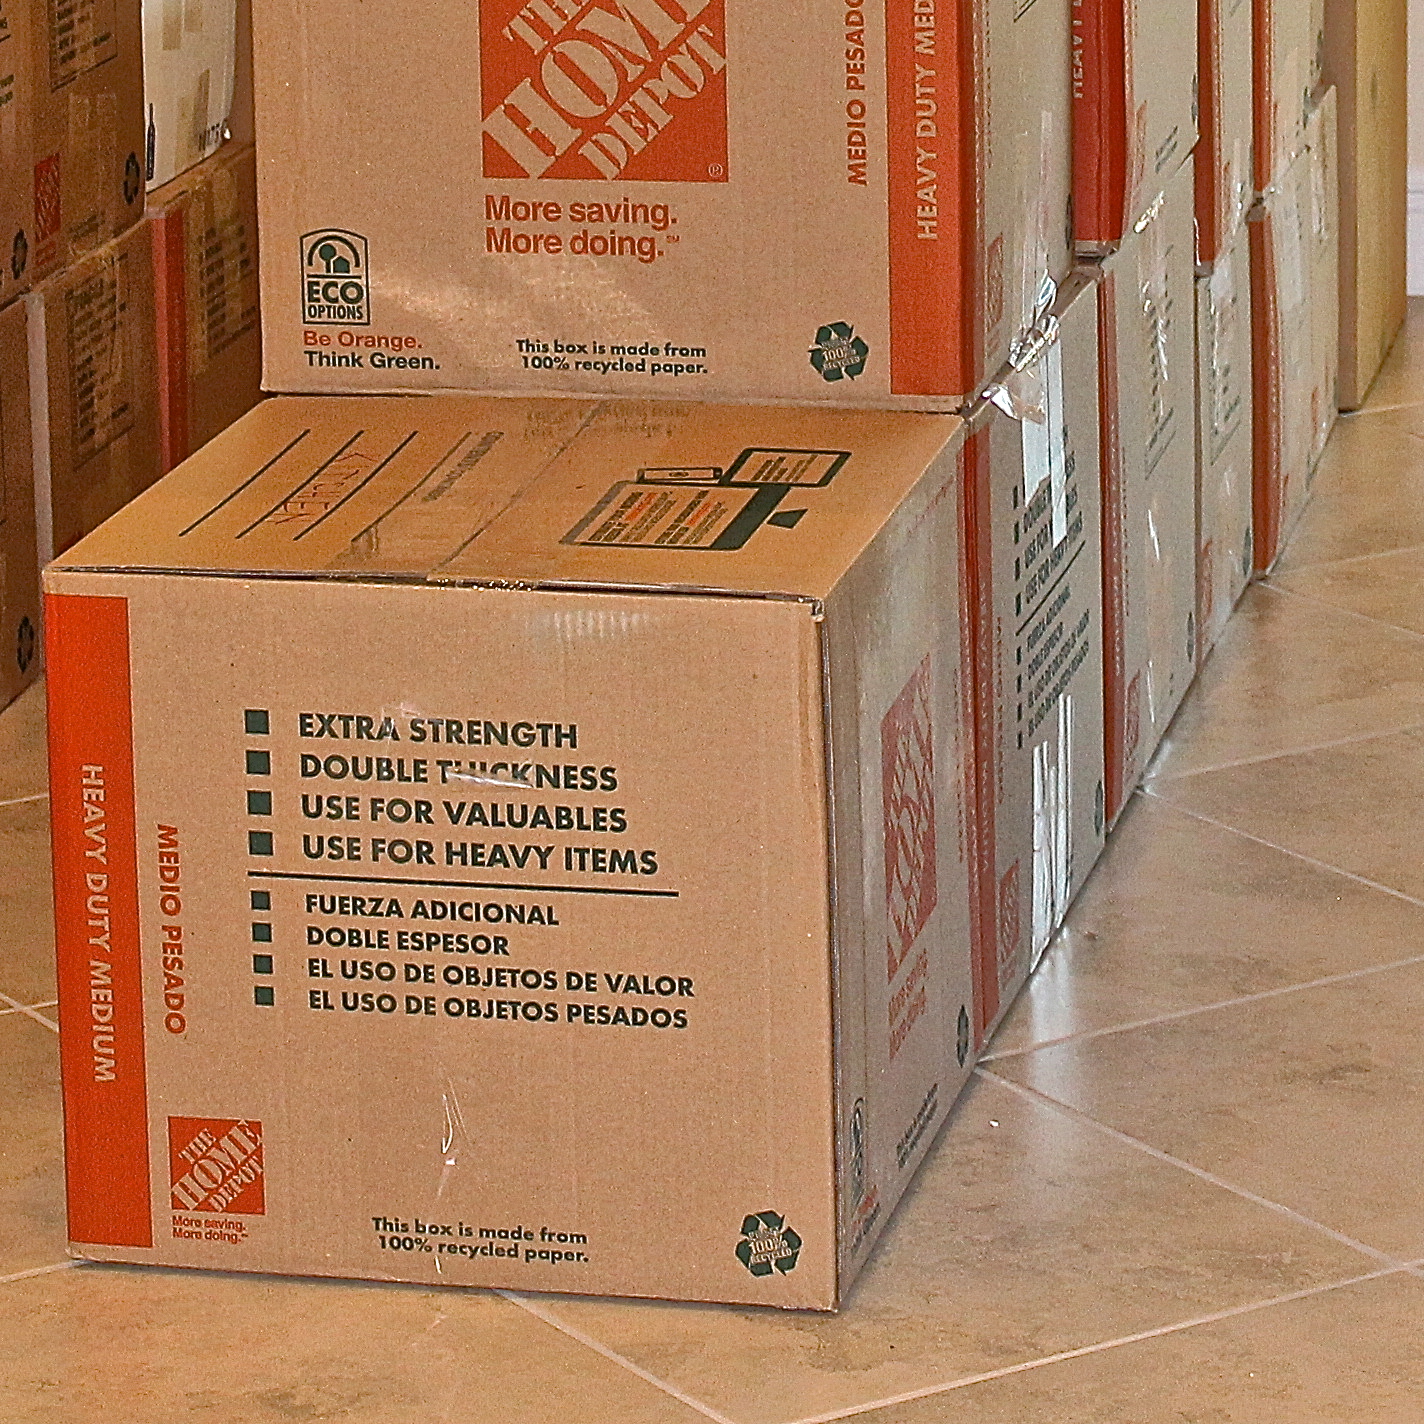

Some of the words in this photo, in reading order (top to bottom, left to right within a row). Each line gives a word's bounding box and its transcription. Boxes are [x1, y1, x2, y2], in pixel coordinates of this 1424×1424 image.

[576, 23, 727, 180] DEPOT
[913, 65, 938, 142] DUTY
[844, 97, 870, 187] MEDIO
[484, 194, 562, 222] More
[569, 196, 679, 229] saving.
[913, 145, 940, 241] HEAVY
[486, 227, 563, 255] More
[569, 228, 665, 264] doing.
[307, 279, 364, 305] ECO
[307, 304, 364, 321] OPTIONS
[303, 330, 331, 347] Be
[337, 331, 423, 351] Orange.
[516, 339, 549, 354] This
[553, 340, 588, 356] box
[592, 341, 607, 356] is
[610, 341, 660, 357] made
[664, 341, 707, 358] from
[304, 350, 363, 369] Think
[369, 352, 441, 372] Green.
[521, 355, 570, 371] 100%
[575, 356, 646, 375] recycled
[651, 359, 708, 377] paper.
[298, 712, 398, 743] EXTRA
[409, 717, 578, 750] STRENGTH
[300, 752, 429, 785] DOUBLE
[81, 763, 107, 865] HEAVY
[301, 794, 362, 824] USE
[370, 795, 435, 826] FOR
[442, 800, 627, 833] VALUABLES
[156, 823, 182, 917] MEDIO
[302, 834, 363, 863] USE
[370, 836, 435, 867] FOR
[444, 841, 556, 873] HEAVY
[563, 845, 658, 876] ITEMS
[86, 873, 113, 954] DUTY
[305, 892, 404, 919] FUERZA
[409, 897, 559, 927] ADICIONAL
[306, 925, 391, 950] DOBLE
[396, 928, 510, 957] ESPESOR
[160, 923, 187, 1035] PESADO
[307, 957, 335, 980] EL
[340, 959, 396, 983] USO
[404, 961, 436, 985] DE
[441, 964, 558, 992] OBJETOS
[564, 969, 598, 993] DE
[603, 972, 695, 998] VALOR
[90, 958, 117, 1083] MEDIUM
[308, 987, 335, 1012] EL
[341, 989, 398, 1015] USO
[404, 992, 438, 1016] DE
[443, 996, 559, 1024] OBJETOS
[565, 1000, 688, 1030] PESADOS
[179, 1126, 217, 1166] THE
[170, 1119, 263, 1212] HOME
[207, 1160, 265, 1213] DEPOT
[172, 1214, 203, 1230] More
[205, 1217, 247, 1233] saving.
[172, 1226, 203, 1241] More
[204, 1229, 242, 1244] doing.
[371, 1215, 410, 1236] This
[413, 1218, 453, 1238] box
[457, 1220, 474, 1239] is
[478, 1221, 534, 1241] made
[538, 1225, 588, 1245] from
[377, 1233, 432, 1254] 100%
[436, 1236, 520, 1260] recycled
[523, 1241, 590, 1265] paper.
